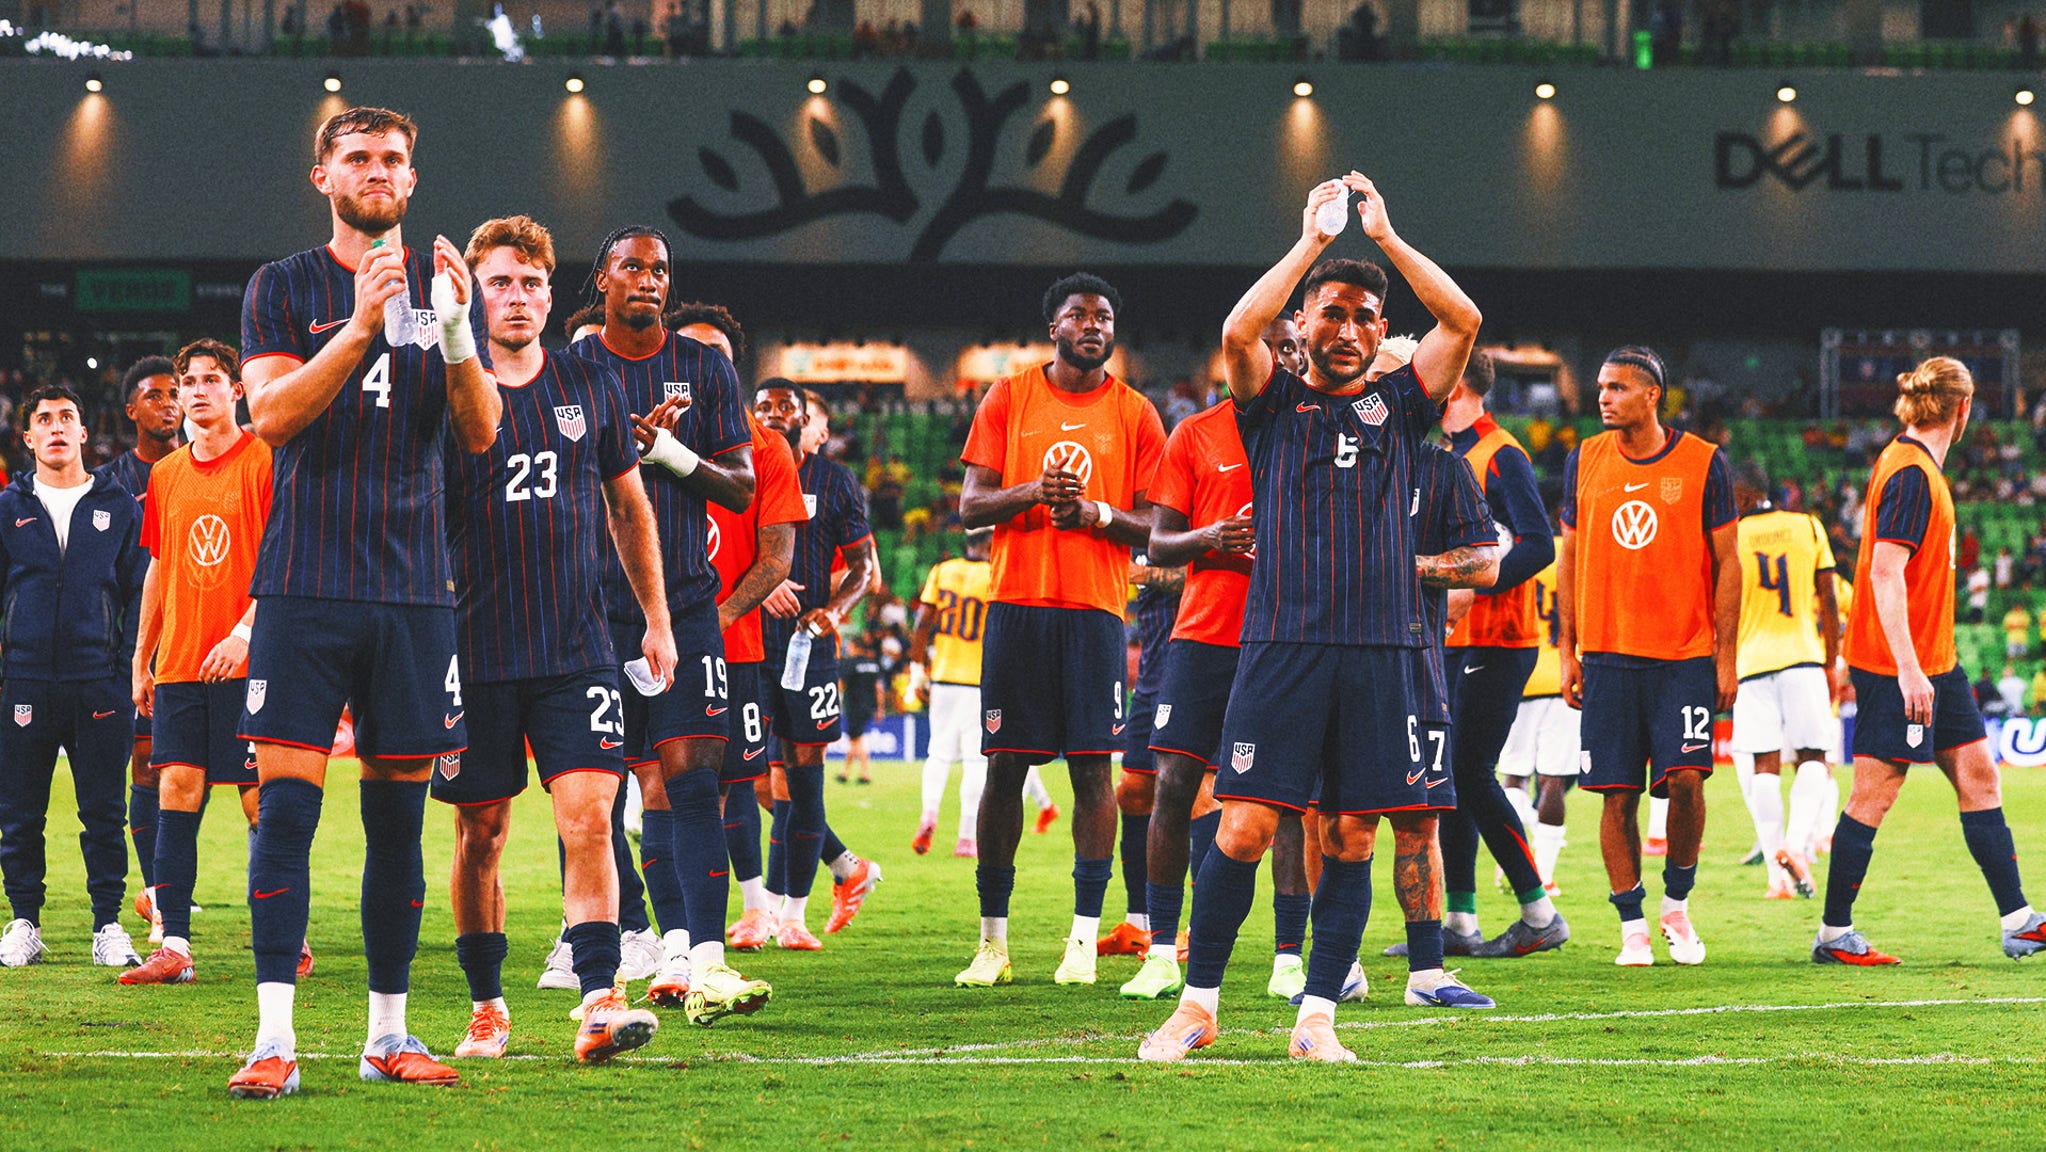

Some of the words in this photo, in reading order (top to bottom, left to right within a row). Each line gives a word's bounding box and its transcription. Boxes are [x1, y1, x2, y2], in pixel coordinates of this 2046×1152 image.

[1713, 132, 1903, 192] DELL
[362, 352, 391, 408] 4
[665, 383, 689, 395] USA
[1354, 393, 1380, 411] USA
[556, 406, 582, 421] USA
[505, 450, 558, 502] 23
[188, 514, 231, 567] VW
[1611, 499, 1659, 550] VW
[1754, 550, 1794, 618] 4
[937, 588, 984, 641] 20
[444, 653, 462, 706] 4
[701, 654, 728, 701] 19
[808, 681, 840, 720] 22
[1113, 680, 1123, 720] 9
[585, 685, 625, 737] 23
[742, 701, 762, 743] 8
[1680, 705, 1711, 741] 12
[1234, 743, 1254, 757] USA
[1407, 714, 1421, 763] 6
[1427, 730, 1445, 772] 7
